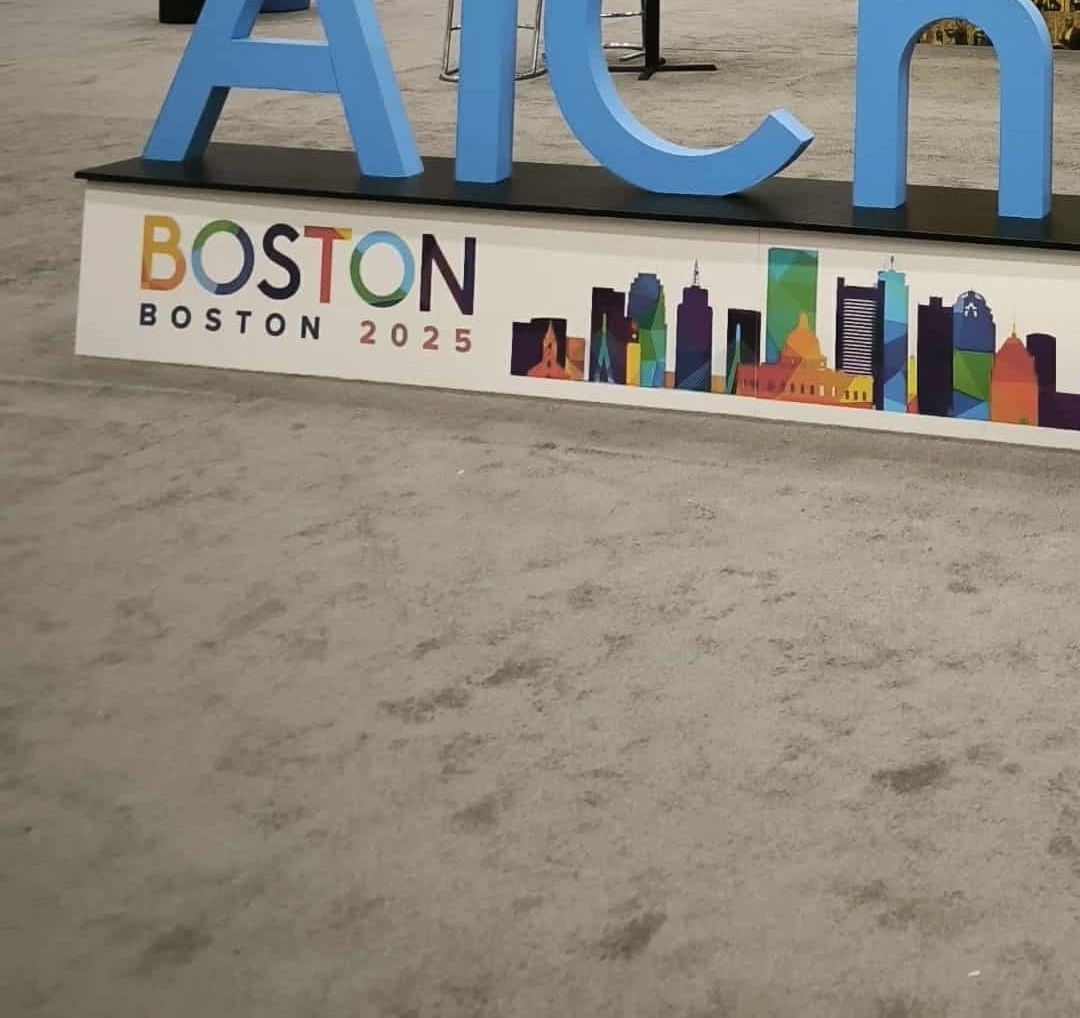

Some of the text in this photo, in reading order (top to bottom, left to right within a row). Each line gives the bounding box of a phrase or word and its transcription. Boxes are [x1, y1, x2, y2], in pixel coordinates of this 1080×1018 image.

[139, 214, 477, 316] BOSTON
[139, 302, 473, 353] BOSTON 2025
